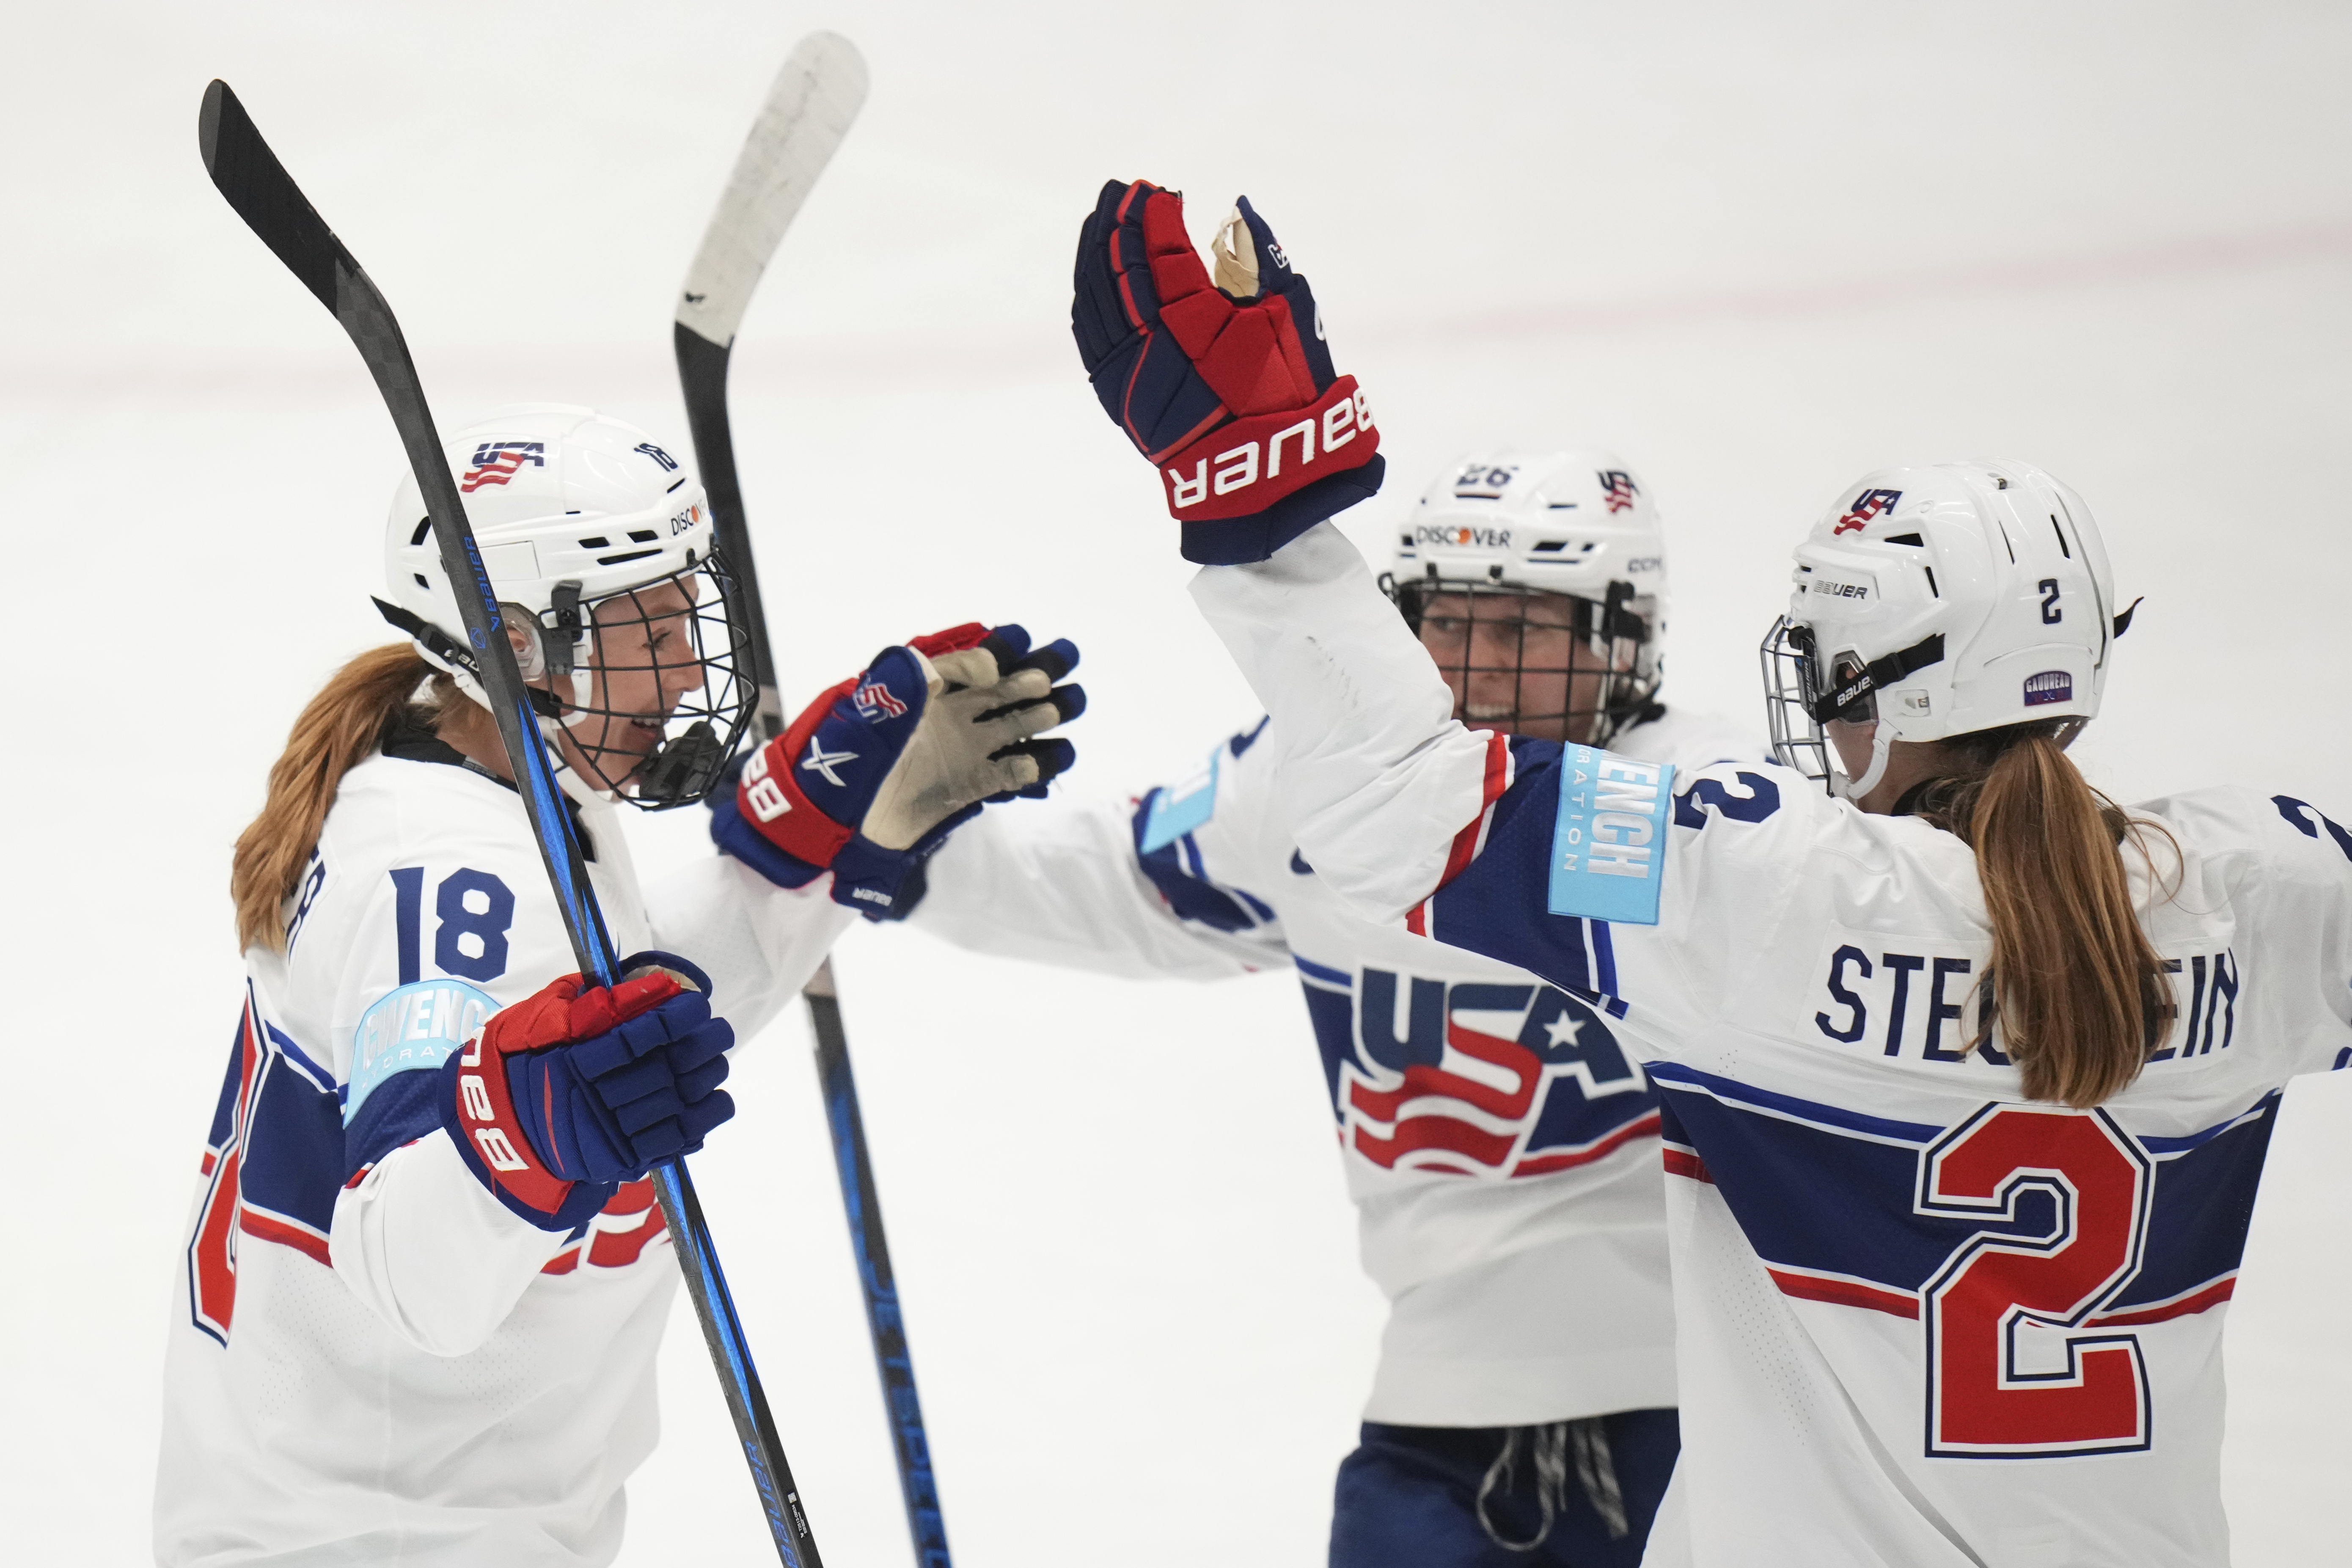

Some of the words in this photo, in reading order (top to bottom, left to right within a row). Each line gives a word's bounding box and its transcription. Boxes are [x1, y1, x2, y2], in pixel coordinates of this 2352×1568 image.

[460, 442, 545, 493] USA
[634, 442, 678, 472] 18
[1598, 470, 1640, 513] USA
[1834, 489, 1903, 535] USA
[1416, 525, 1511, 547] DISCOVER
[2039, 578, 2062, 624] 2
[1837, 676, 1873, 706] BAUE
[2026, 673, 2070, 693] GAUDREAU
[1587, 751, 1662, 878] ENCH
[388, 867, 515, 987] 18
[363, 988, 492, 1071] CWENC
[1340, 961, 1648, 1181] USA
[1917, 1101, 2156, 1460] 2
